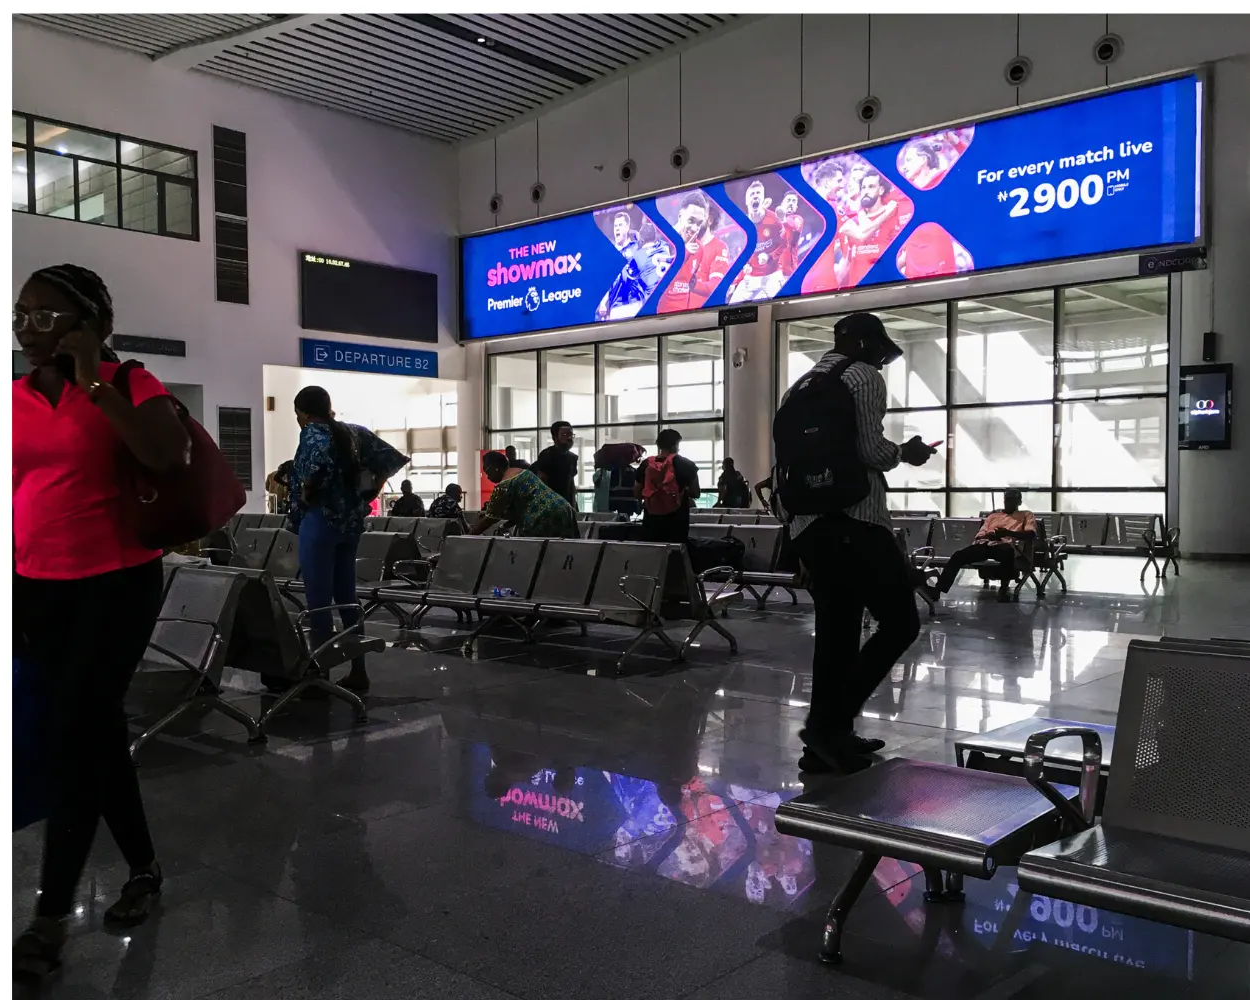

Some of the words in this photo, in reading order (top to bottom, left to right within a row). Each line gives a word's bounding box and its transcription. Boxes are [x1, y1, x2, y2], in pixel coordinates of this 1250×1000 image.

[977, 169, 1004, 184] For
[1008, 160, 1054, 178] every
[1059, 146, 1114, 169] match
[1120, 140, 1153, 158] live
[1107, 168, 1130, 183] PM
[509, 246, 529, 259] THE
[531, 240, 556, 255] NEW
[487, 252, 582, 287] showmax
[488, 295, 524, 311] Premier
[542, 287, 582, 303] League
[335, 350, 411, 368] DEPARTURE
